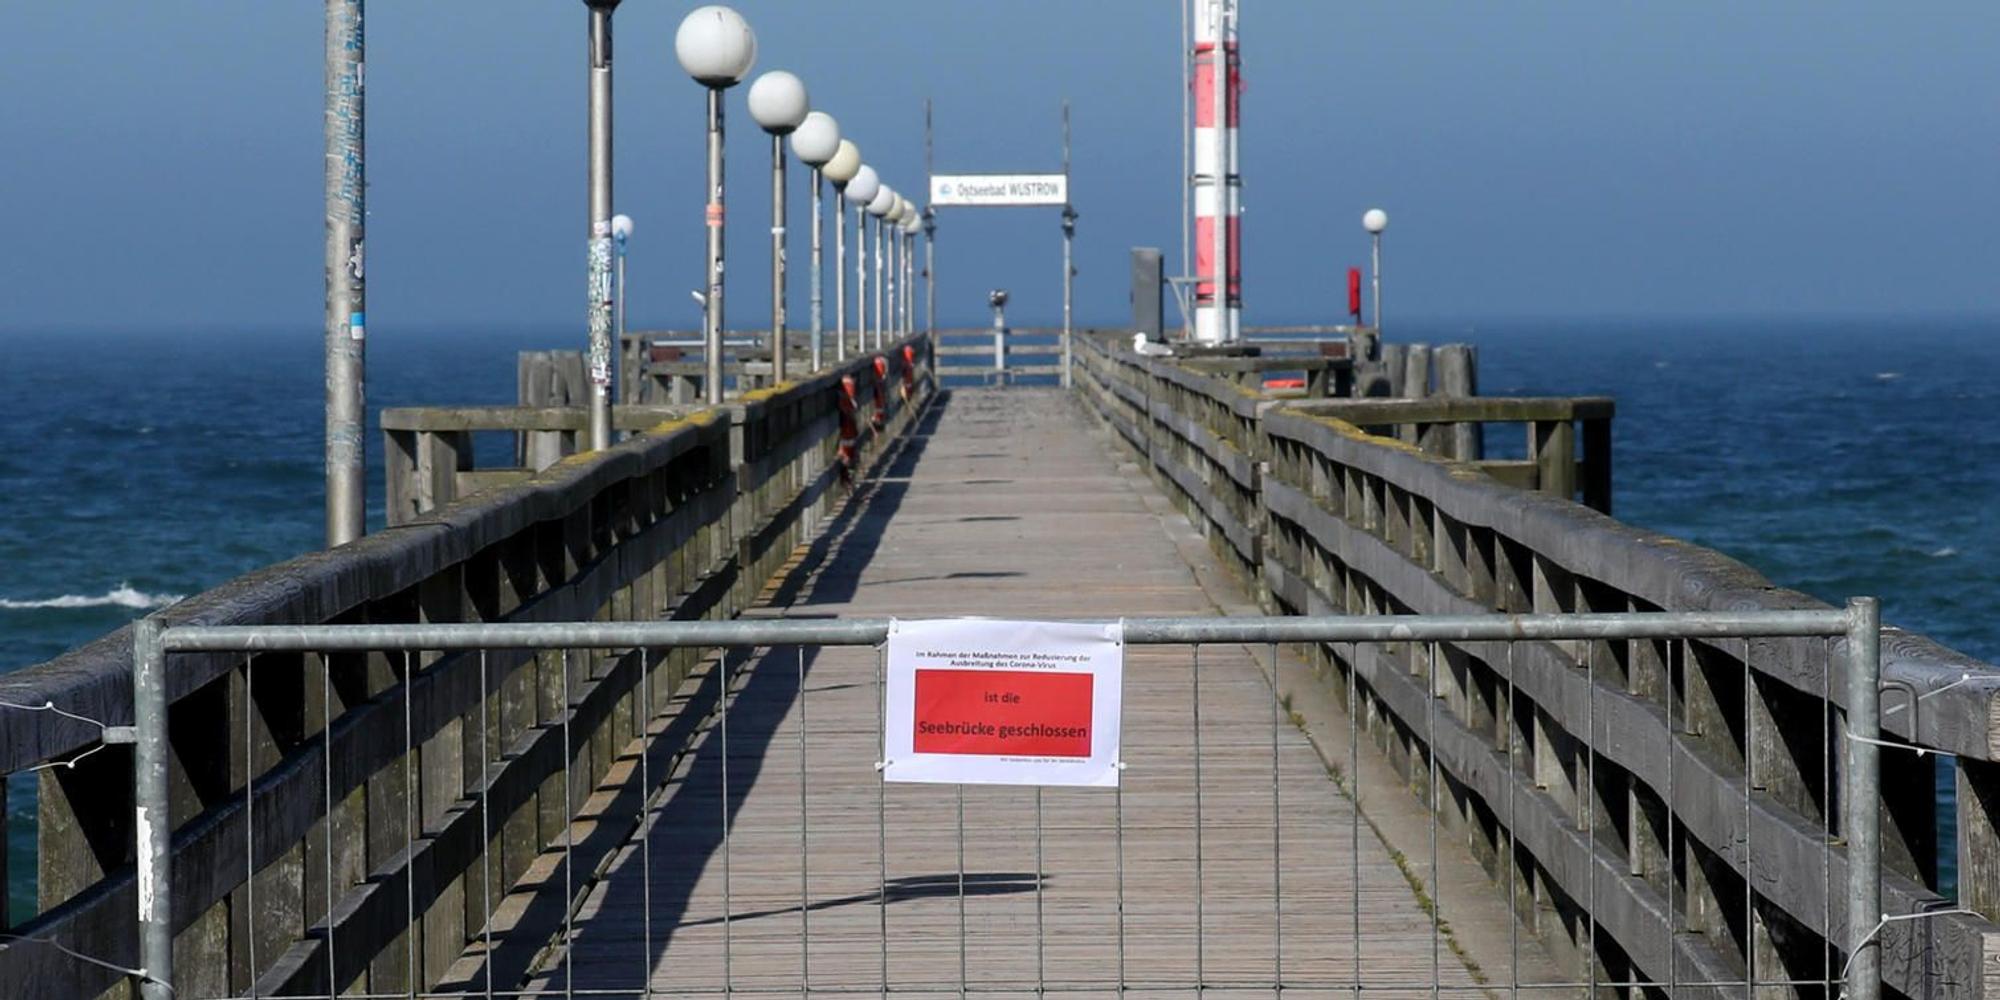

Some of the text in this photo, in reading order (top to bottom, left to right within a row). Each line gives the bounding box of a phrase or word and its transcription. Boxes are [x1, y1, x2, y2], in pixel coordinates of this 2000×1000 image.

[957, 183, 1059, 197] Ostseebad WUSTROW
[1032, 653, 1077, 662] Reduzierung
[950, 660, 993, 668] Ausbreitung
[985, 692, 1021, 704] ist die
[919, 721, 1088, 738] Seebrücke geschlossen
